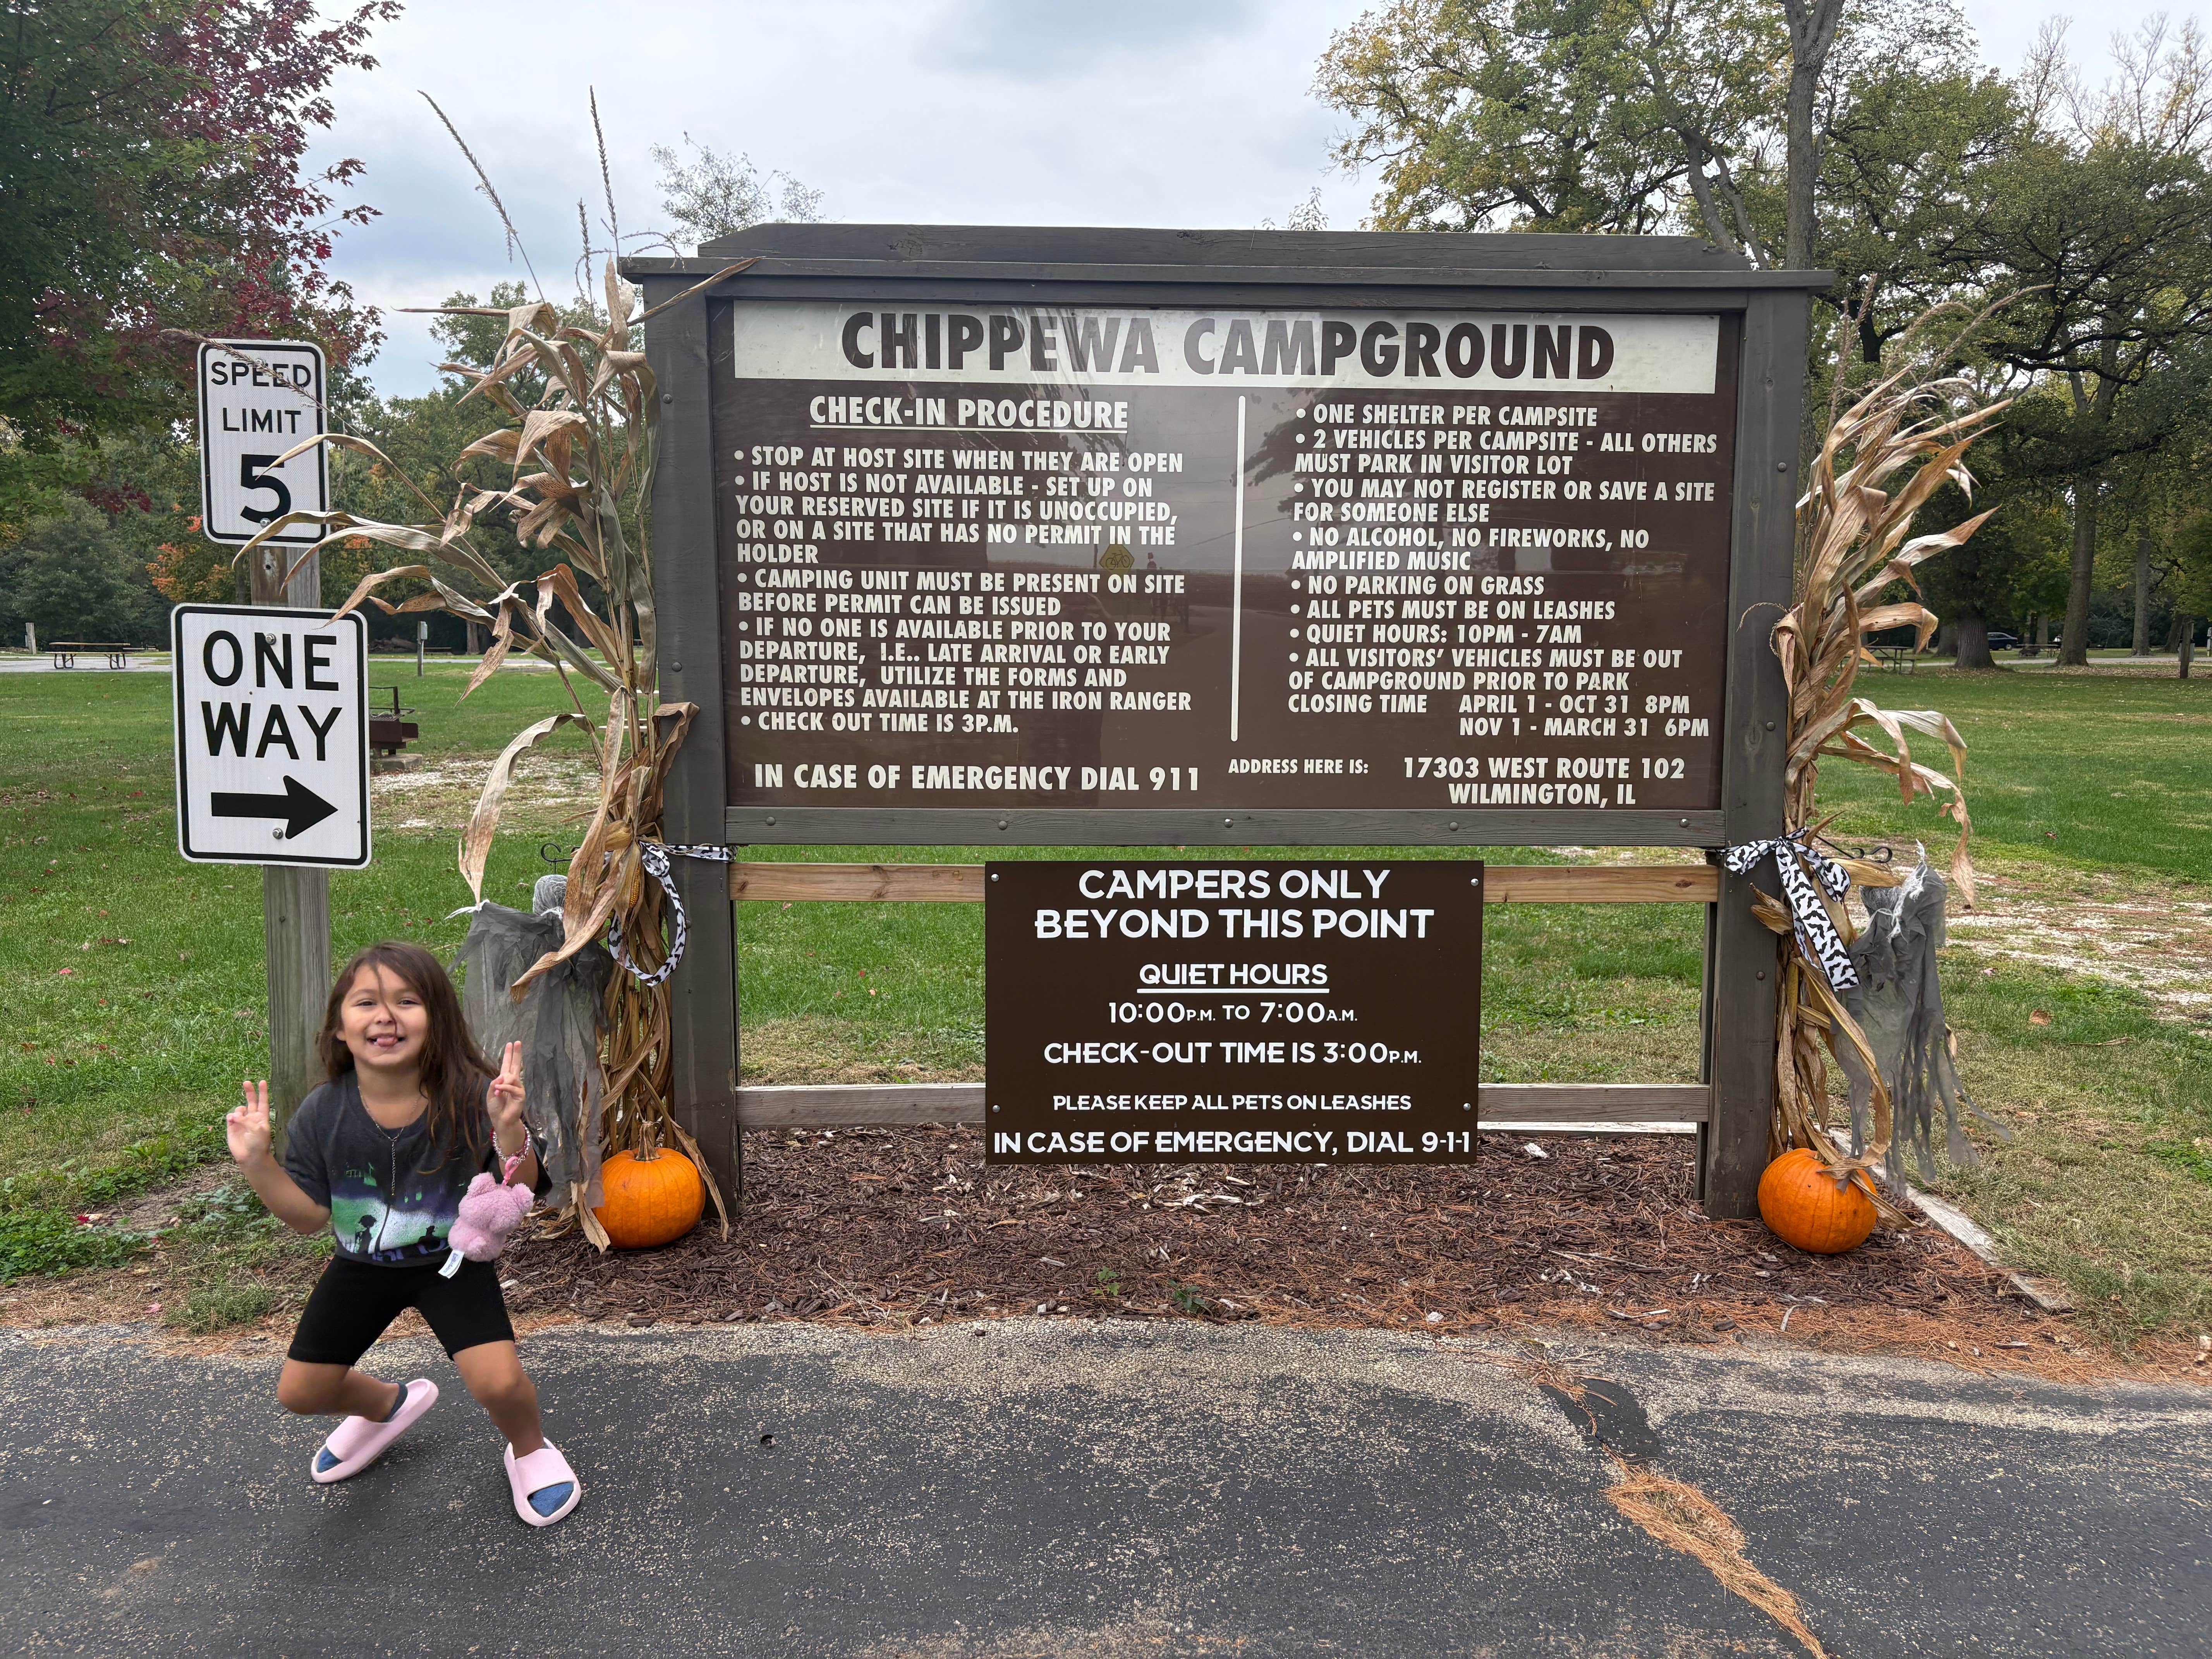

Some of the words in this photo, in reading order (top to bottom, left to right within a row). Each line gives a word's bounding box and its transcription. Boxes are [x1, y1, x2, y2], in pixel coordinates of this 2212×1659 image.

[842, 312, 1159, 373] CHIPPEWA
[1184, 318, 1614, 380] CAMPGROUND
[211, 361, 311, 387] SPEED
[222, 408, 301, 433] LIMIT
[809, 395, 946, 426] CHECK-IN
[958, 398, 1128, 429] PROCEDURE
[1313, 403, 1355, 424] ONE
[1362, 404, 1445, 424] SHELTER
[1452, 405, 1491, 425] PER
[1498, 405, 1597, 427] CAMPSITE
[751, 445, 804, 466] STOP
[811, 447, 836, 467] AT
[843, 447, 896, 468] HOST
[903, 448, 945, 469] SITE
[952, 449, 1014, 470] WHEN
[1022, 451, 1073, 471] THEY
[1080, 451, 1120, 472] ARE
[1127, 452, 1183, 472] OPEN
[1294, 453, 1351, 473] MUST
[1358, 453, 1413, 474] PARK
[1420, 454, 1443, 474] IN
[1449, 454, 1529, 474] VISITOR
[1537, 455, 1573, 475] LOT
[240, 454, 291, 523] 5
[1310, 478, 1353, 498] YOU
[1360, 478, 1407, 498] MAY
[1413, 479, 1455, 499] NOT
[1462, 479, 1556, 500] REGISTER
[1563, 480, 1592, 500] OR
[1599, 481, 1647, 500] SAVE
[1654, 481, 1668, 501] A
[1675, 482, 1715, 501] SITE
[735, 495, 795, 515] YOUR
[802, 496, 905, 517] RESERVED
[912, 498, 953, 519] SITE
[962, 499, 979, 519] IF
[988, 500, 1006, 519] IT
[1014, 500, 1032, 520] IS
[1039, 500, 1178, 526] UNOCCUPIED,
[1293, 501, 1333, 522] FOR
[1340, 502, 1439, 522] SOMEONE
[1446, 503, 1490, 523] ELSE
[1309, 527, 1339, 546] NO
[1345, 527, 1444, 550] ALCOHOL,
[1451, 527, 1481, 547] NO
[1489, 528, 1613, 552] FIREWORKS,
[1620, 529, 1649, 549] NO
[737, 543, 819, 564] HOLDER
[1291, 550, 1400, 570] AMPLIFIED
[1407, 551, 1471, 571] MUSIC
[754, 568, 853, 589] CAMPING
[861, 570, 909, 590] UNIT
[916, 571, 973, 591] MUST
[980, 572, 1005, 592] BE
[1013, 573, 1101, 593] PRESENT
[1108, 574, 1137, 593] ON
[1144, 574, 1185, 594] SITE
[1308, 575, 1338, 595] NO
[1345, 575, 1437, 595] PARKING
[1444, 575, 1474, 595] ON
[1480, 575, 1544, 596] GRASS
[738, 592, 817, 612] BEFORE
[825, 593, 903, 614] PERMIT
[910, 594, 951, 615] CAN
[959, 596, 984, 615] BE
[992, 596, 1061, 616] ISSUED
[1306, 599, 1341, 619] ALL
[1348, 599, 1395, 619] PETS
[1401, 600, 1457, 619] MUST
[1464, 600, 1489, 619] BE
[1496, 600, 1526, 620] ON
[1533, 600, 1615, 620] LEASHES
[203, 630, 339, 690] ONE
[740, 640, 866, 665] DEPARTURE,
[880, 642, 920, 662] I.E..
[928, 643, 972, 663] LATE
[980, 644, 1066, 664] ARRIVAL
[1073, 644, 1102, 664] OR
[1109, 645, 1170, 665] EARLY
[1305, 648, 1340, 667] ALL
[1346, 648, 1444, 667] VISITORS'
[1451, 648, 1542, 668] VEHICLES
[1549, 649, 1605, 668] MUST
[1611, 649, 1636, 668] BE
[1643, 649, 1683, 668] OUT
[740, 663, 866, 688] DEPARTURE,
[881, 665, 956, 685] UTILIZE
[963, 666, 1000, 686] THE
[1008, 667, 1077, 687] FORMS
[1084, 668, 1127, 687] AND
[1288, 671, 1314, 690] OF
[1321, 671, 1466, 690] CAMPGROUND
[1473, 671, 1536, 690] PRIOR
[1543, 672, 1568, 690] TO
[1576, 672, 1630, 691] PARK
[741, 687, 855, 708] ENVELOPES
[862, 689, 969, 709] AVAILABLE
[977, 690, 1001, 709] AT
[1007, 690, 1044, 709] THE
[1052, 690, 1102, 710] IRON
[1110, 691, 1192, 711] RANGER
[202, 701, 342, 761] WAY
[758, 711, 824, 731] CHECK
[831, 712, 872, 732] OUT
[879, 713, 928, 732] TIME
[936, 713, 954, 732] IS
[755, 763, 783, 788] IN
[793, 764, 857, 788] CASE
[867, 764, 900, 789] OF
[912, 765, 1072, 790] EMERGENCY
[1081, 766, 1139, 790] DIAL
[1149, 766, 1198, 791] 911
[1228, 759, 1298, 774] ADDRESS
[1304, 759, 1343, 774] HERE
[1349, 759, 1369, 774] IS:
[1404, 757, 1479, 778] 17303
[1487, 757, 1549, 778] WEST
[1556, 757, 1630, 779] ROUTE
[1642, 757, 1685, 779] 102
[1448, 783, 1608, 809] WILMINGTON,
[1617, 783, 1636, 805] IL
[1079, 869, 1271, 899] CAMPERS
[1279, 869, 1391, 899] ONLY
[1034, 909, 1209, 939] BEYOND
[1218, 908, 1304, 938] THIS
[1312, 908, 1435, 938] POINT
[1139, 963, 1225, 985] QUIET
[1230, 963, 1328, 985] HOURS
[1222, 1005, 1250, 1020] TO
[1044, 1042, 1212, 1064] CHECK-OUT
[1219, 1042, 1285, 1063] TIME
[1292, 1042, 1316, 1063] IS
[1053, 1095, 1131, 1111] PLEASE
[1134, 1094, 1188, 1110] KEEP
[1191, 1094, 1229, 1110] ALL
[1231, 1094, 1283, 1110] PETS
[1286, 1094, 1317, 1110] ON
[1321, 1094, 1412, 1110] LEASHES
[994, 1132, 1021, 1154] IN
[1027, 1131, 1105, 1153] CASE
[1110, 1131, 1150, 1152] OF
[1154, 1131, 1338, 1156] EMERGENCY,
[1346, 1131, 1414, 1152] DIAL
[1421, 1131, 1470, 1153] 9-1-1
